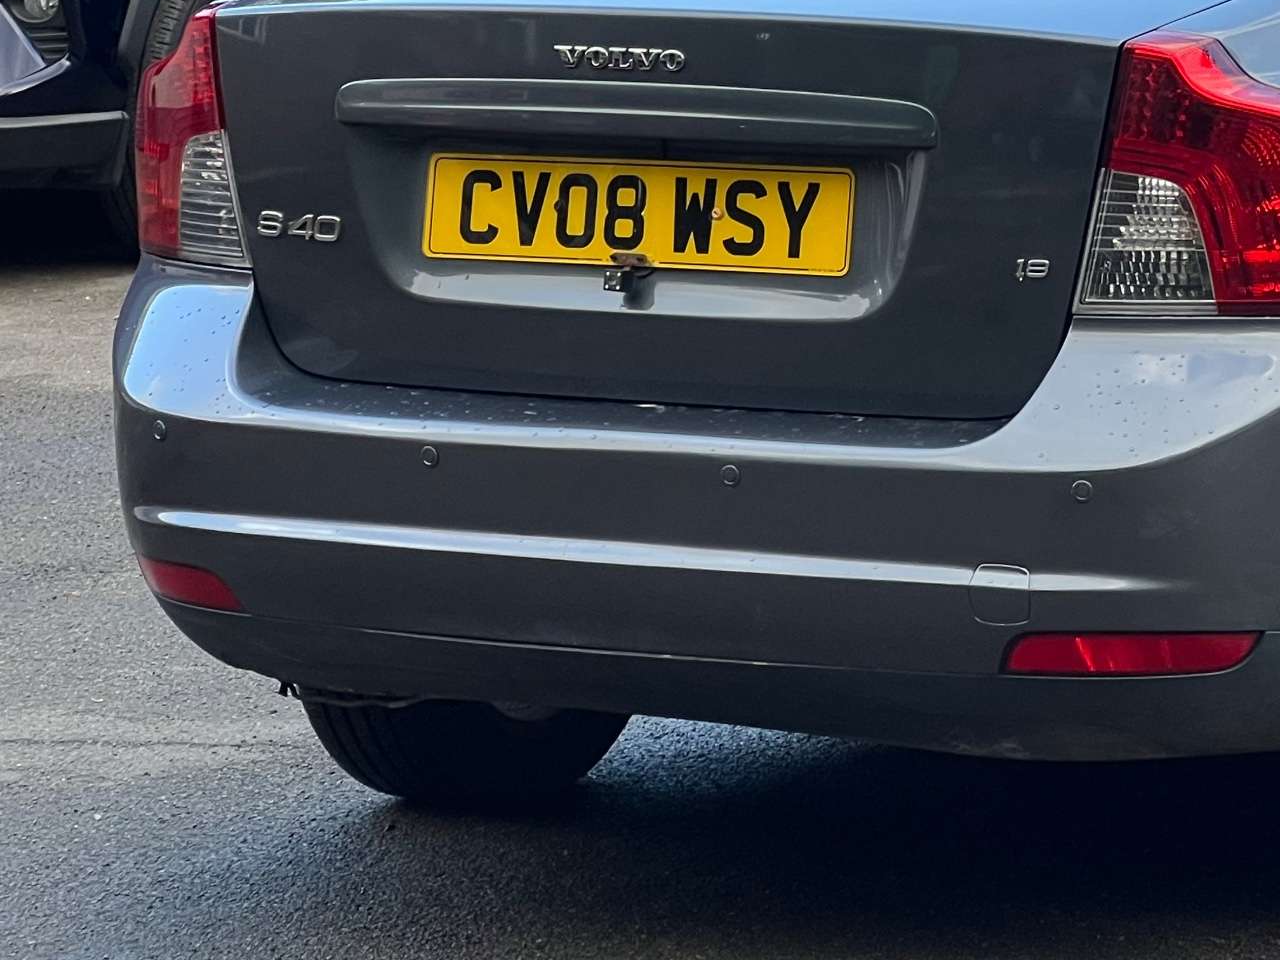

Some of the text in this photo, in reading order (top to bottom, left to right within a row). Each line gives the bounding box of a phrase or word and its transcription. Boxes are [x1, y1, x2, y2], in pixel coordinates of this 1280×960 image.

[553, 45, 685, 72] VOLVO
[257, 211, 341, 241] S40
[459, 169, 822, 259] CV08 WSY
